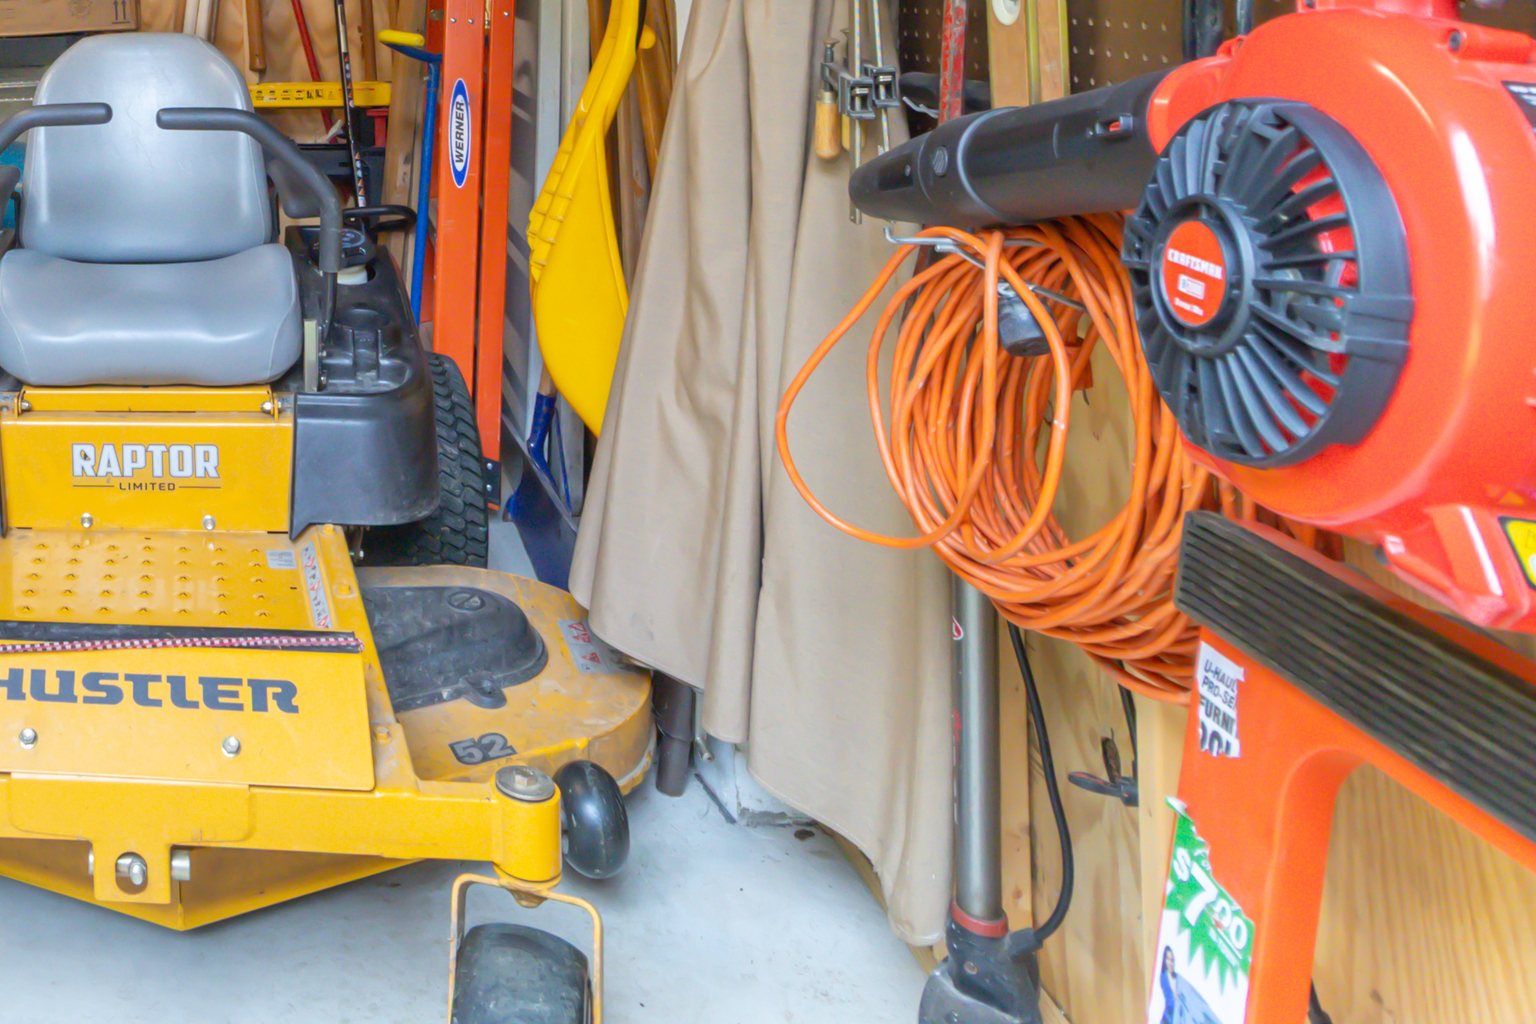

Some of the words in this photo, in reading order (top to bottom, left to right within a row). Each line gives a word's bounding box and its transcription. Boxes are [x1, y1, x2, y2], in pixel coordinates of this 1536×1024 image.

[455, 100, 464, 164] WERNER
[1168, 248, 1223, 280] CRAFTSMAN
[72, 443, 221, 478] RAPTOR
[119, 482, 176, 491] LIMITED
[1202, 675, 1236, 710] PRO-SE
[450, 733, 516, 764] 52
